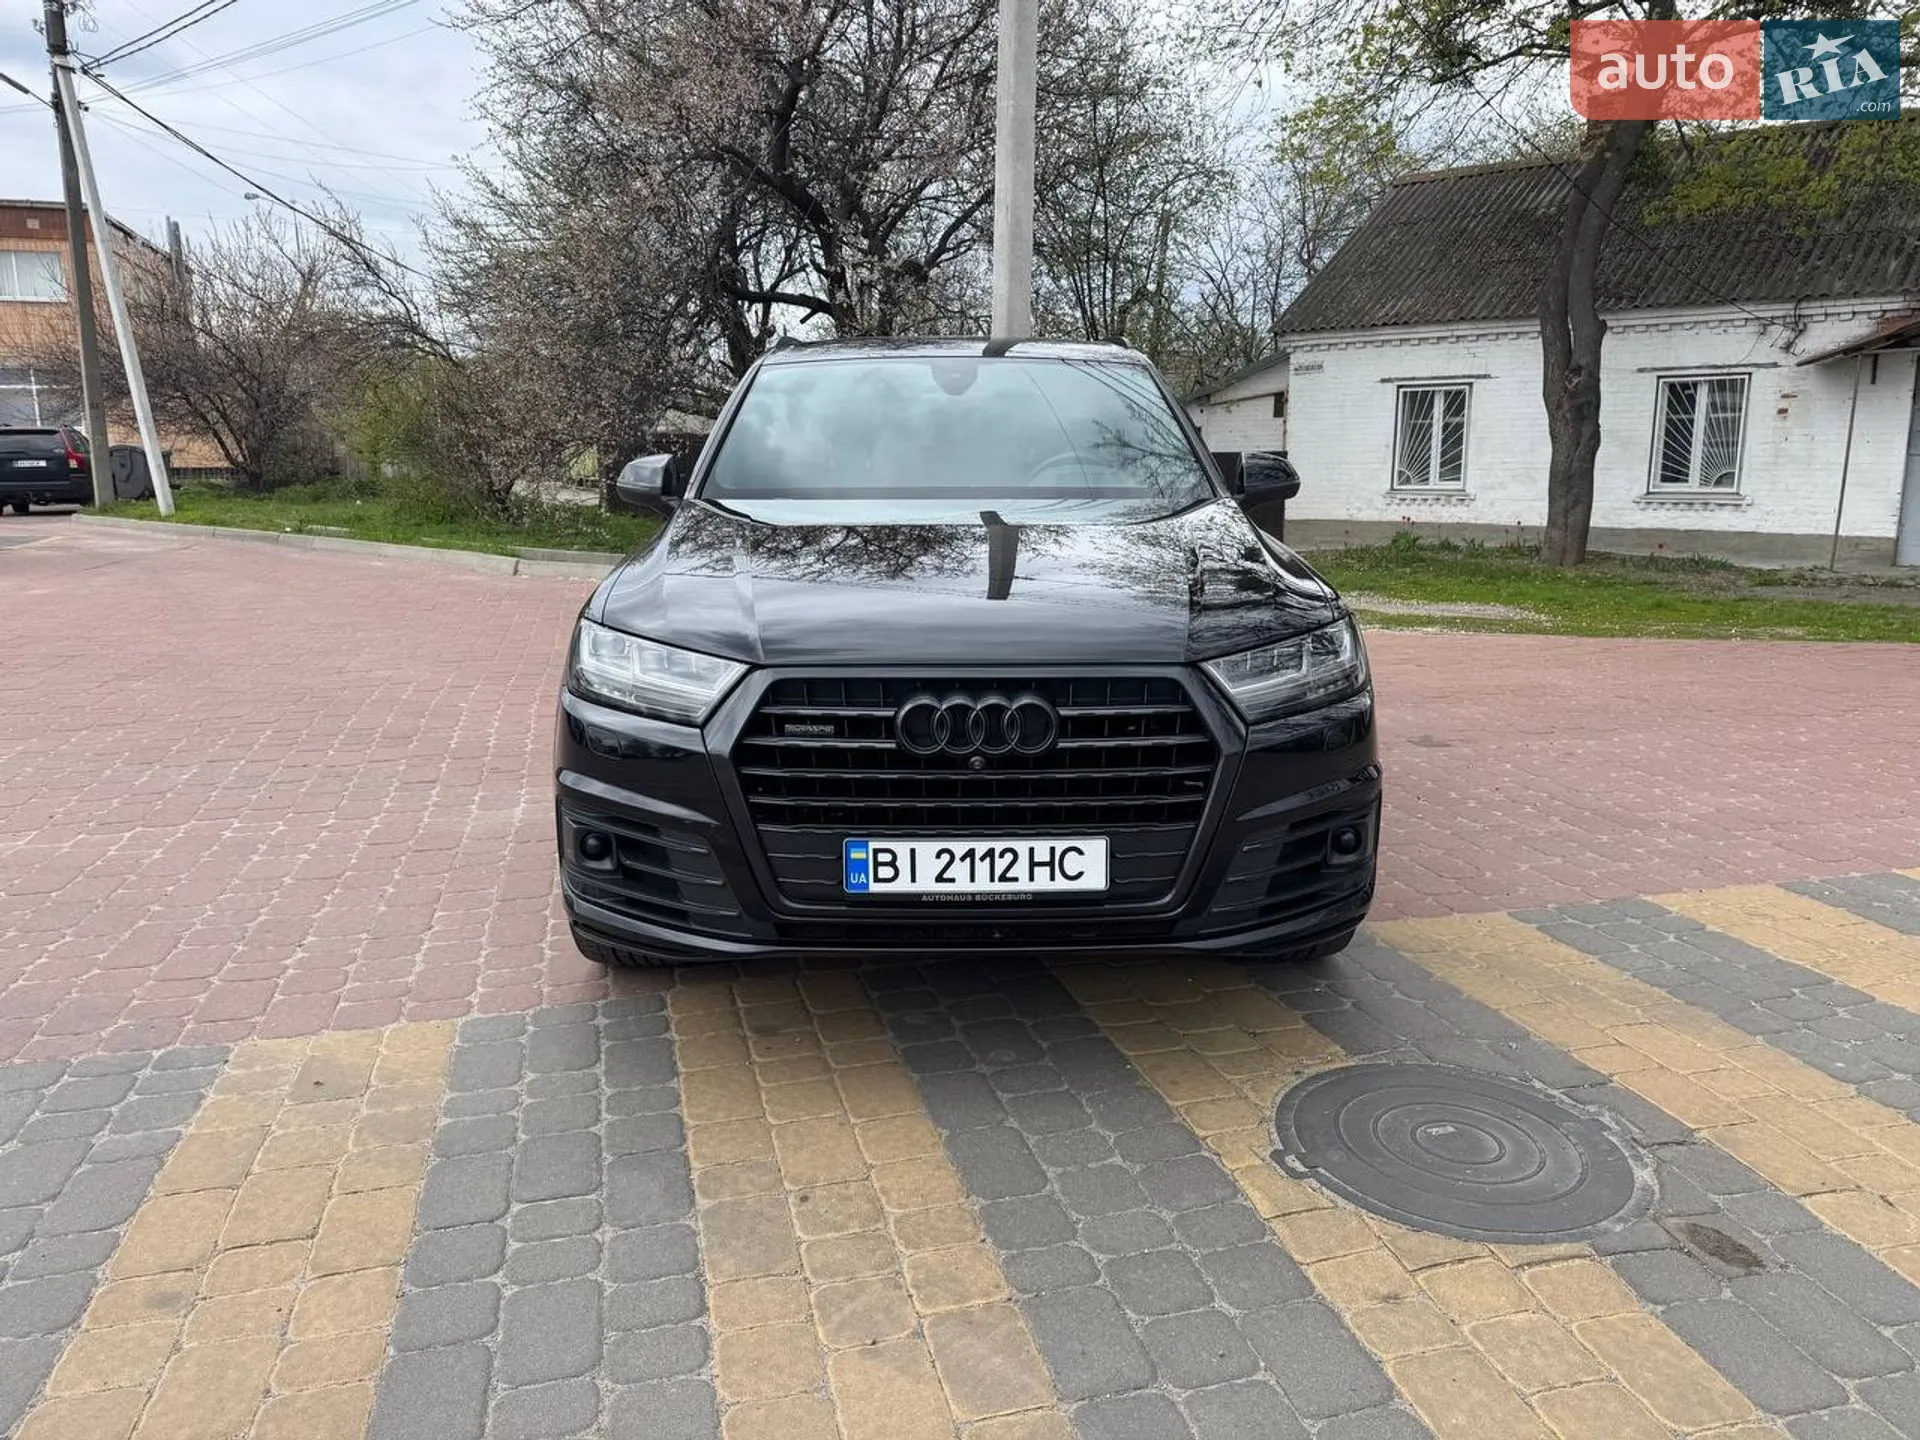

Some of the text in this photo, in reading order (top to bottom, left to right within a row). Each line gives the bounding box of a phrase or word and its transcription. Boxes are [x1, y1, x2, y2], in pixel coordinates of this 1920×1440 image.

[872, 846, 1085, 883] BI 2112 HC
[850, 872, 867, 884] UA
[921, 894, 972, 902] AUTOHAUS
